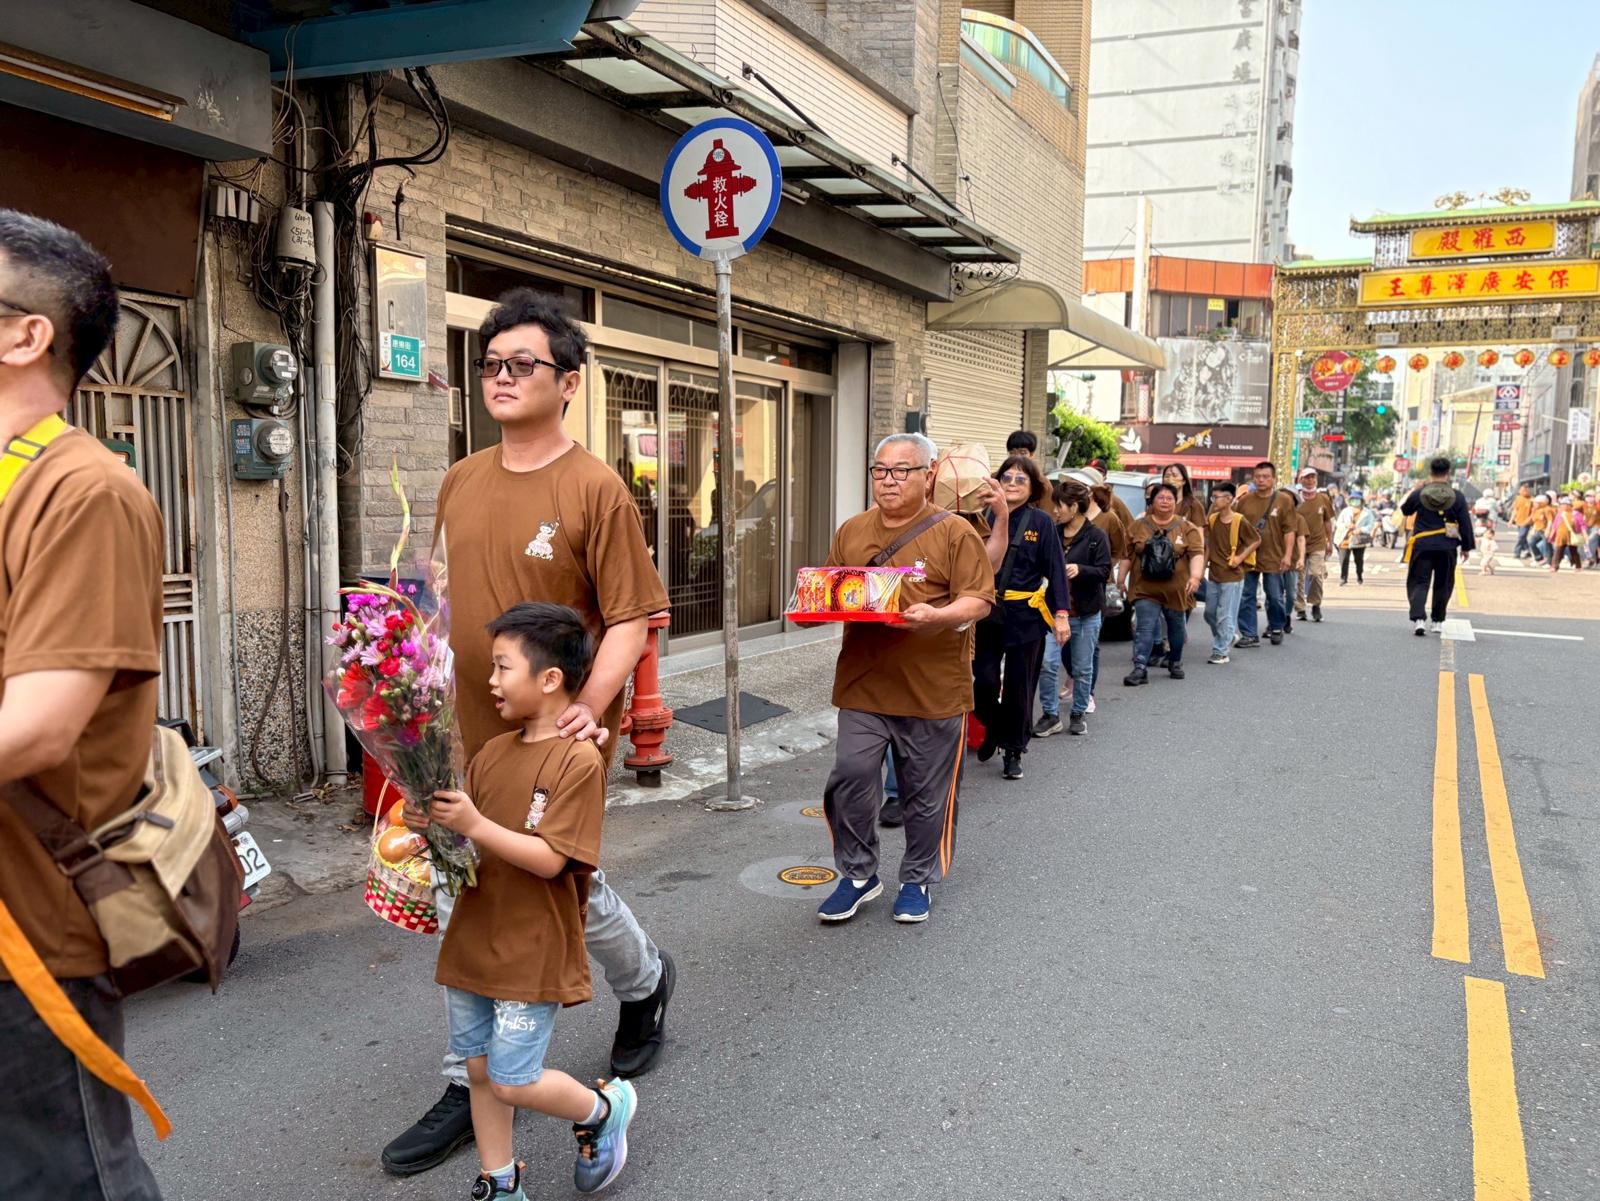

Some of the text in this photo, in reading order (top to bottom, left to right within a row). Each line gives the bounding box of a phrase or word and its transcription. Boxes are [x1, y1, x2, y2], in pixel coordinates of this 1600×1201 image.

[713, 176, 729, 228] 救火栓
[1437, 226, 1527, 251] 西羅殿
[1388, 269, 1570, 297] 保安廣澤尊王
[395, 353, 416, 369] 164
